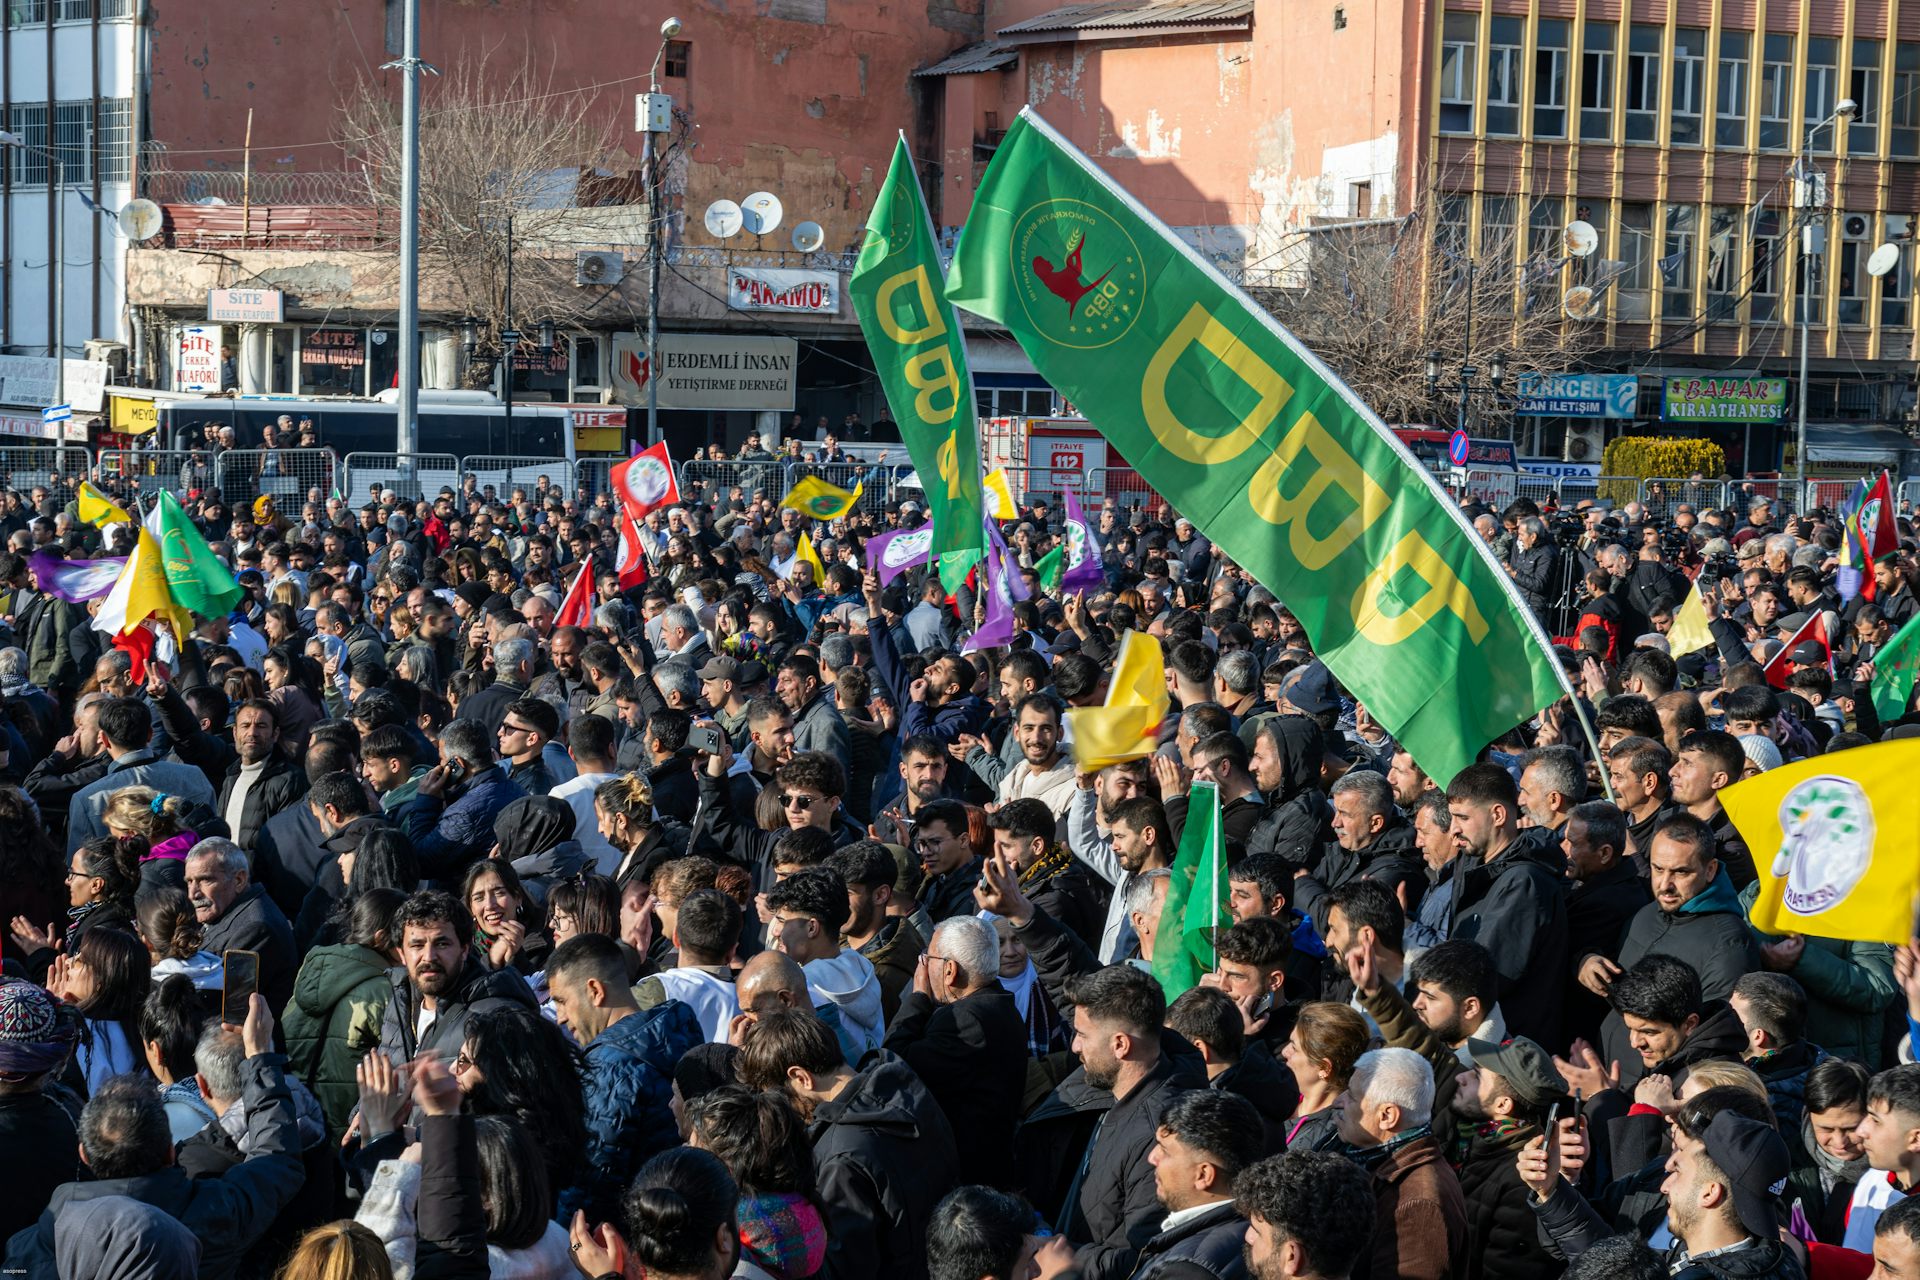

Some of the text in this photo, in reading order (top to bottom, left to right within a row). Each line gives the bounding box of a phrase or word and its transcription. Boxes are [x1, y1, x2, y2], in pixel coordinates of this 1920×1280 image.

[185, 356, 210, 365] ERKEK
[667, 351, 791, 370] ERDEMLİ İNSAN
[668, 375, 788, 392] YETİŞTİRME DERNEĞİ
[1685, 379, 1769, 400] BAHAR
[1055, 455, 1079, 470] 112
